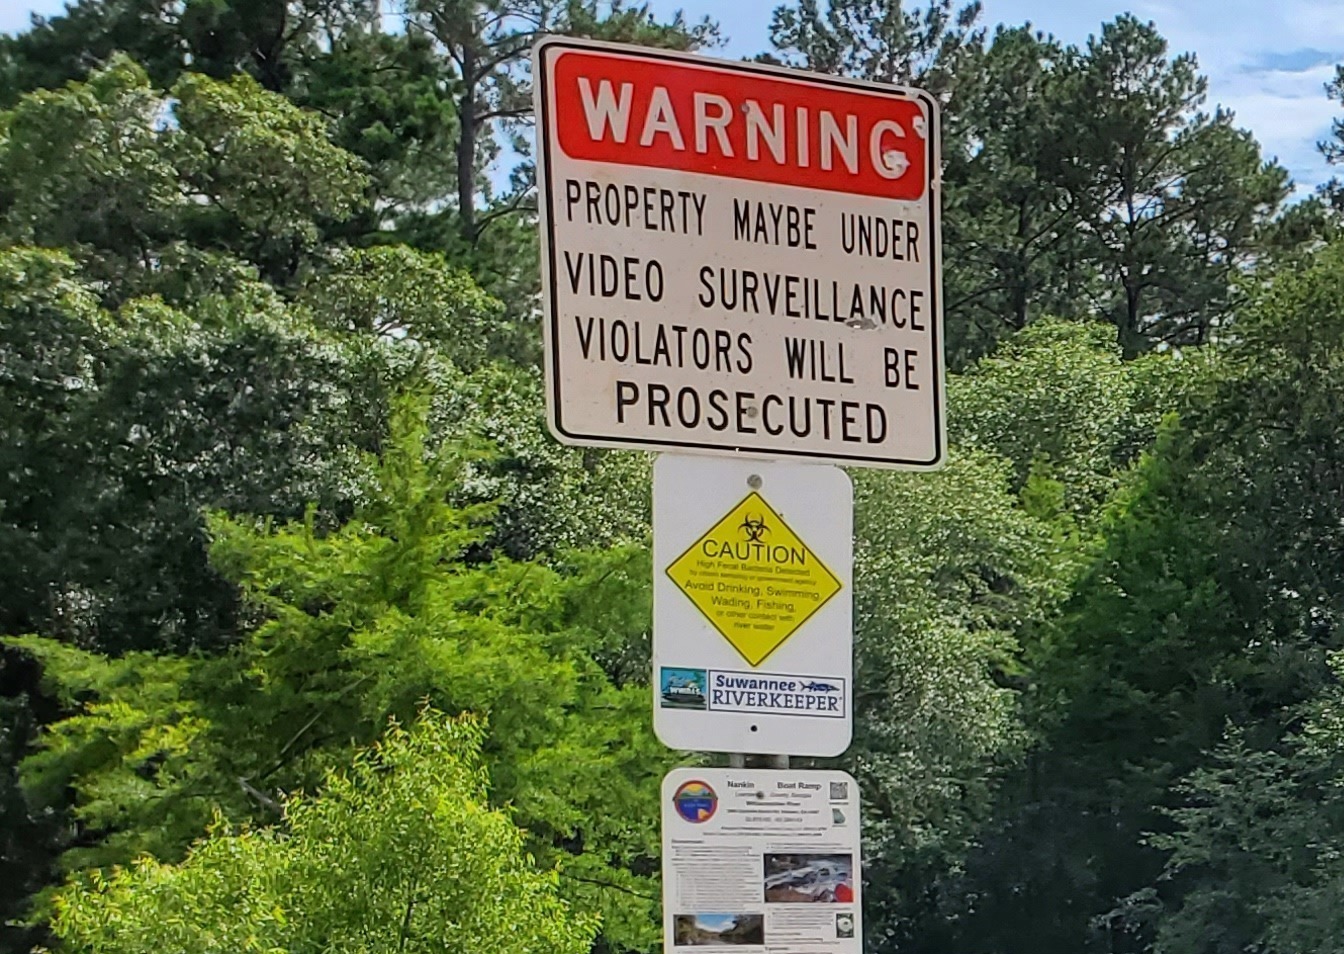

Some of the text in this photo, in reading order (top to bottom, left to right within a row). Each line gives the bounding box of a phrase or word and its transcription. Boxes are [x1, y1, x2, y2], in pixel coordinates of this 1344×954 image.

[577, 77, 908, 179] WARNING
[566, 180, 920, 262] PROPERTY MAYBE UNDER
[564, 251, 925, 332] VIDEO SURVEILLANCE
[575, 316, 919, 390] VIOLATORS WILL BE
[616, 380, 887, 444] PROSECUTED
[697, 560, 715, 569] High
[702, 539, 806, 565] CAUTION
[685, 580, 715, 591] Avoid
[718, 582, 763, 597] Drinking,
[716, 674, 796, 692] Suwannee
[798, 782, 822, 791] Ramp
